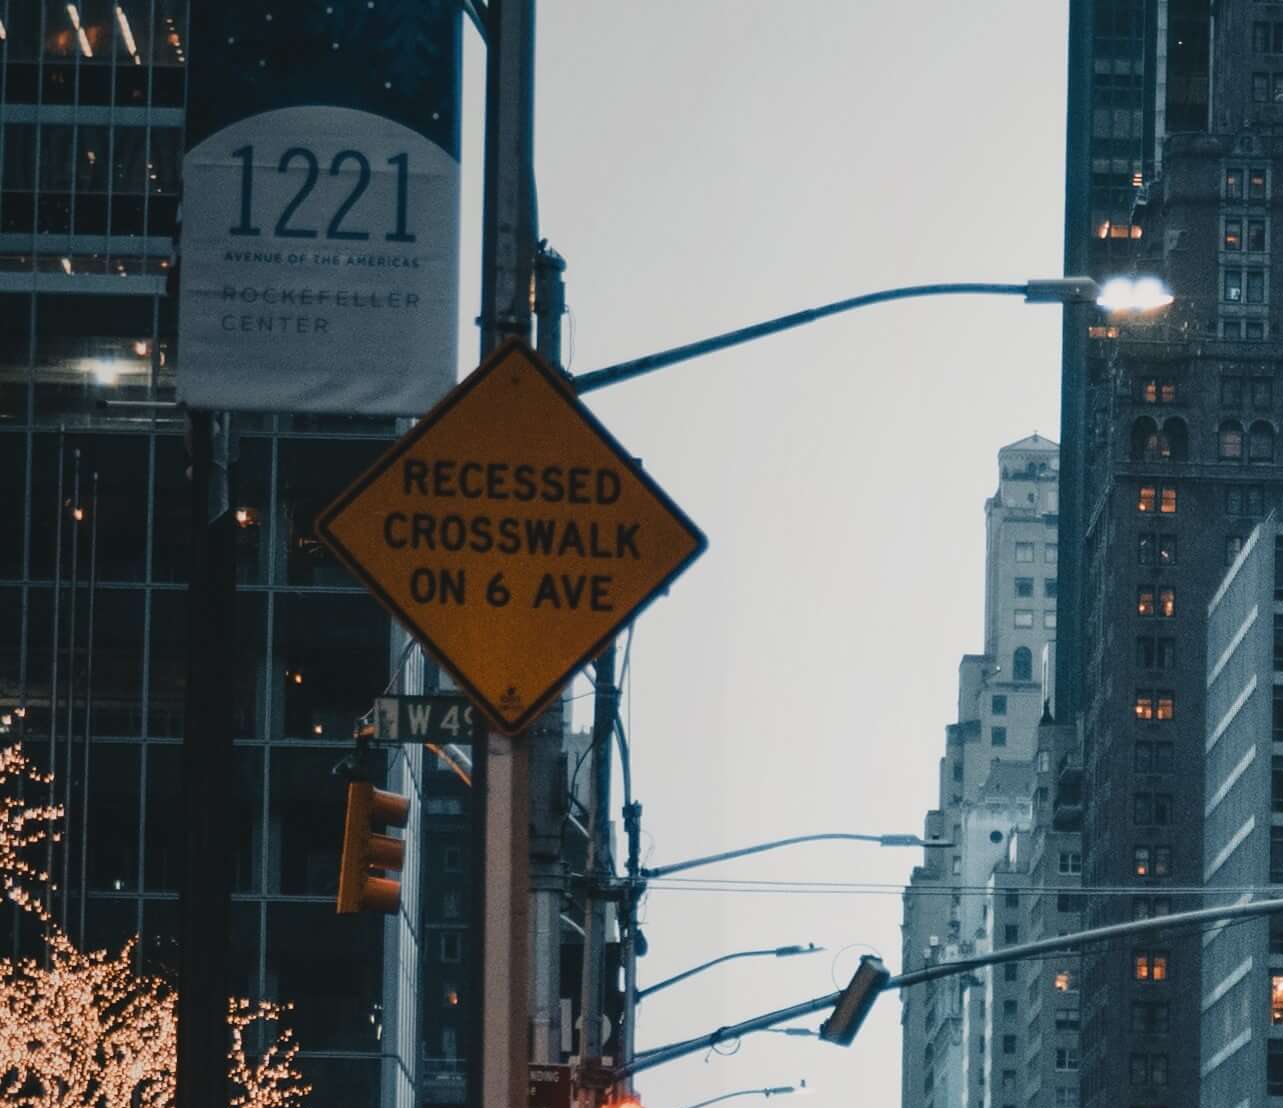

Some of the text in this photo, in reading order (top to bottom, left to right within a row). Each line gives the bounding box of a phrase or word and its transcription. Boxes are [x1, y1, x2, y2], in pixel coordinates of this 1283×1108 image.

[229, 145, 416, 242] 1221
[224, 252, 420, 268] AVENUE OF THE AMERICAS
[223, 287, 420, 308] ROCKEFELLER
[222, 314, 328, 333] CENTER
[403, 460, 621, 504] RECESSED
[384, 513, 641, 560] CROSSWALK
[410, 567, 614, 612] ON 6 AVE
[407, 704, 431, 736] W
